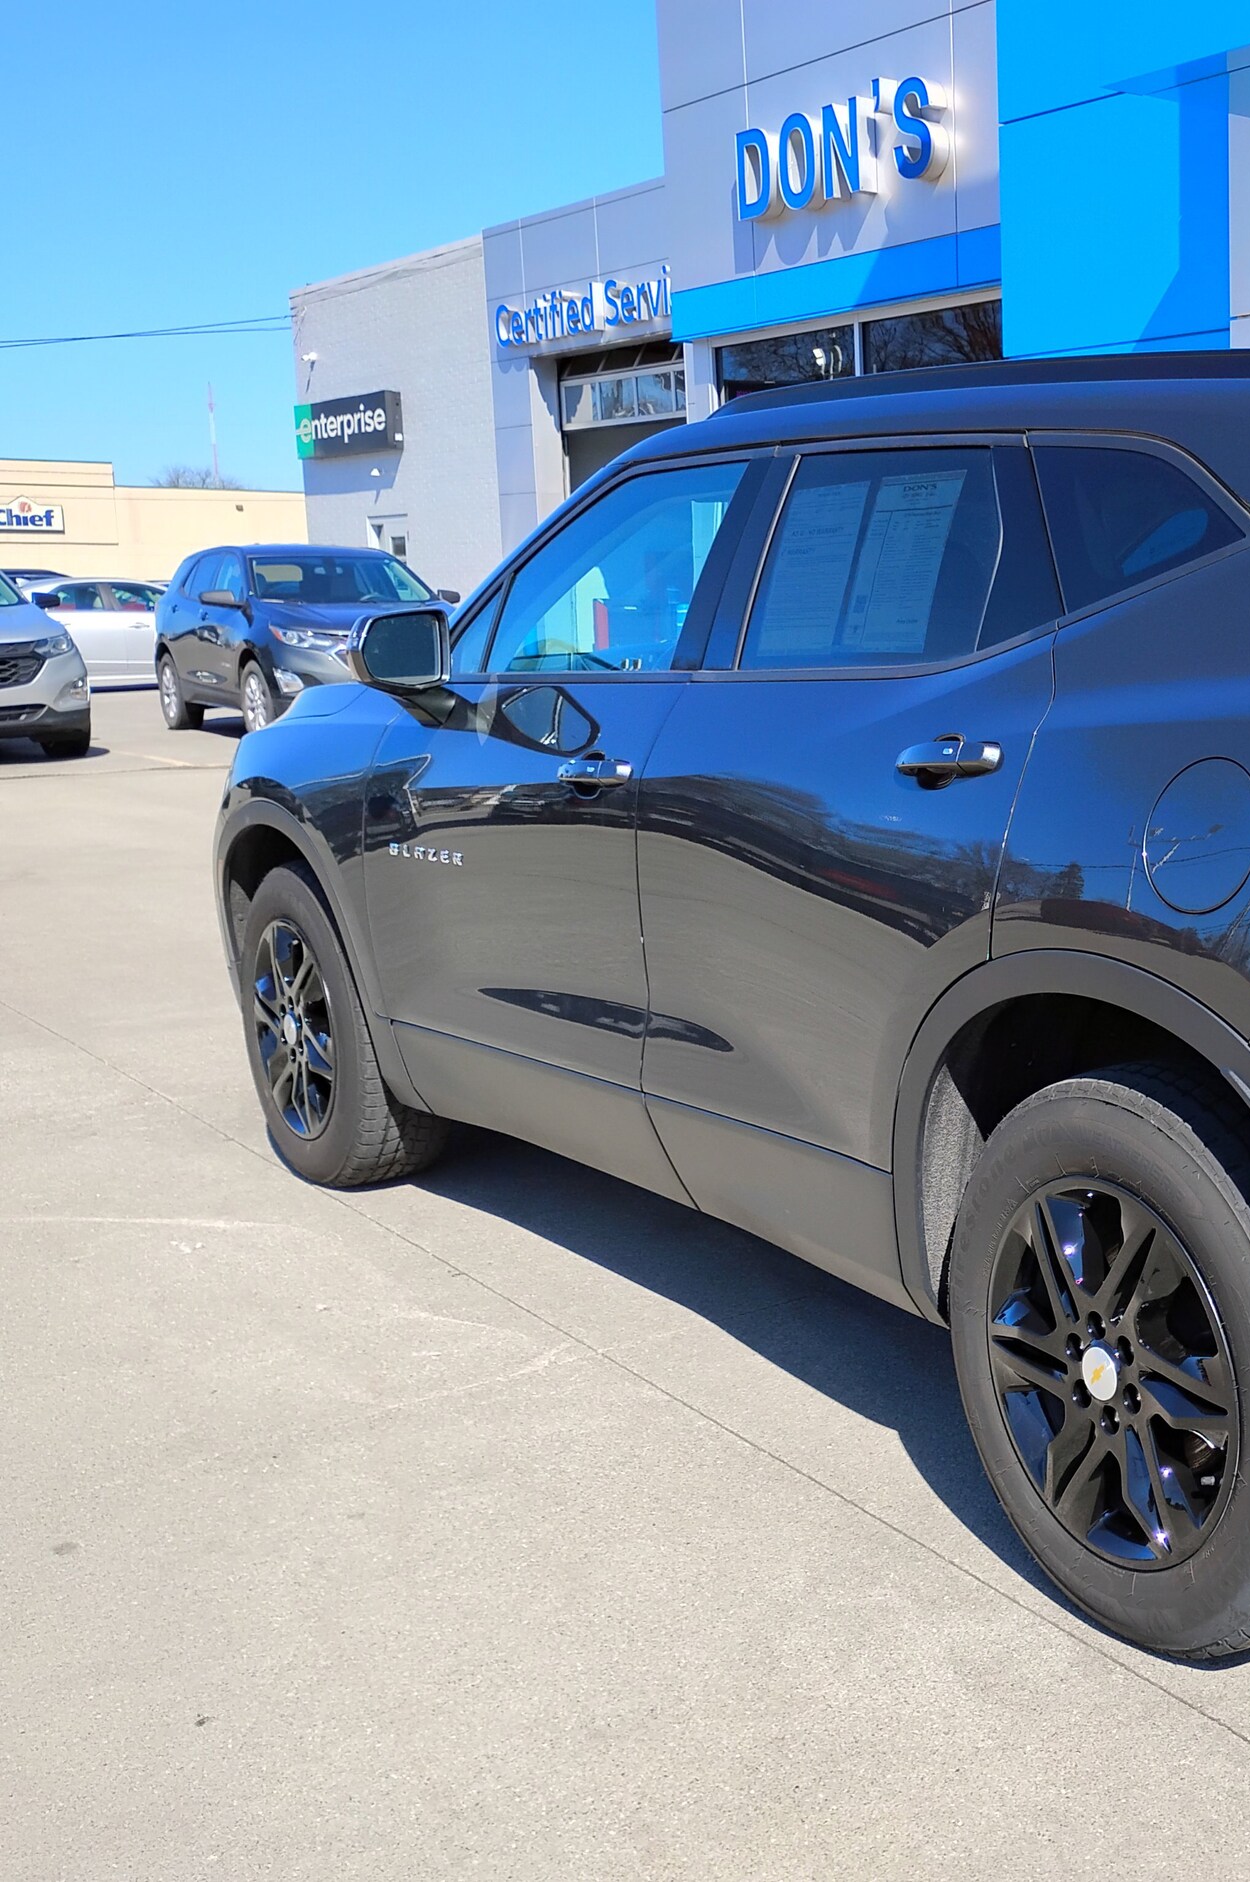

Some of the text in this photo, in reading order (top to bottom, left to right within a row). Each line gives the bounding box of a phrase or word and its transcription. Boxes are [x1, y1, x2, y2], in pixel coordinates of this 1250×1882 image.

[735, 76, 940, 222] DON'S
[496, 283, 598, 348] Certified
[299, 403, 386, 444] enterprise
[388, 842, 463, 866] BLAZER
